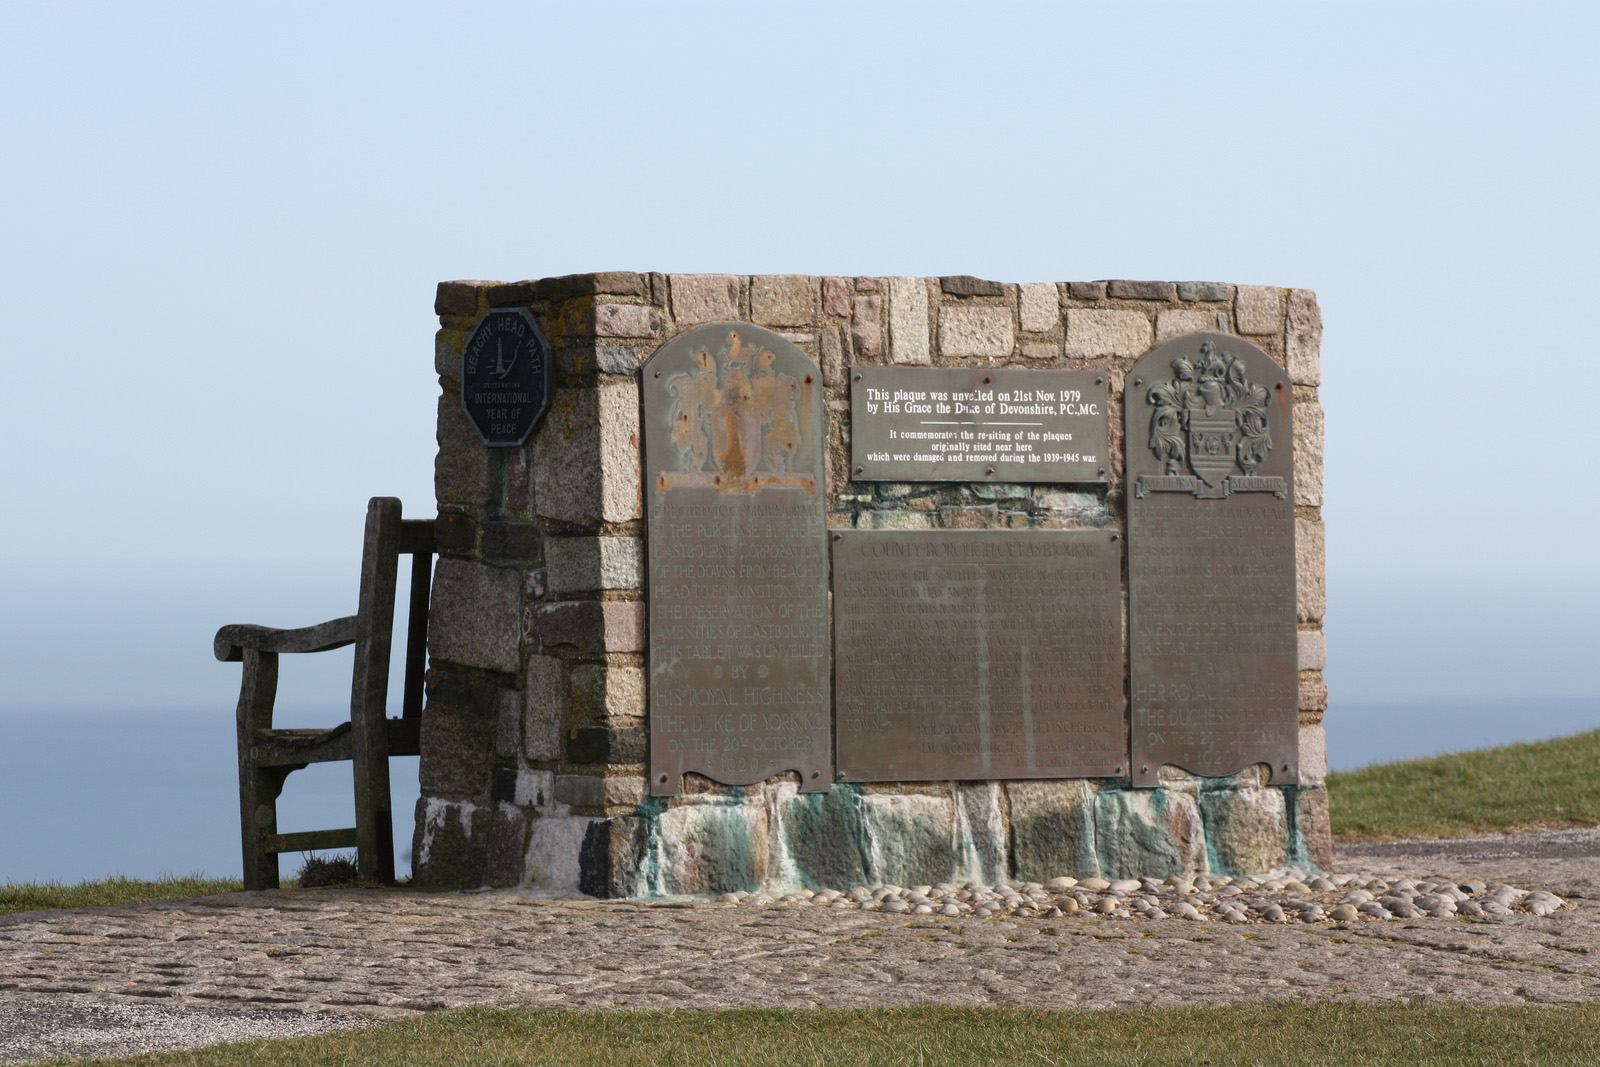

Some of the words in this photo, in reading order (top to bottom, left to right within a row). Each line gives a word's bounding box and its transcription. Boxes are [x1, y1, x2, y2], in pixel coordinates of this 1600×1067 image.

[467, 322, 493, 375] BEACHY
[498, 317, 526, 338] HEAD
[526, 337, 542, 375] PATH
[474, 392, 533, 405] INTERNATIONAL
[866, 388, 890, 401] This
[894, 389, 927, 404] plaque
[930, 391, 948, 402] was
[998, 392, 1011, 402] on
[1013, 390, 1033, 402] 21st
[1036, 390, 1056, 402] Nov.
[1060, 390, 1081, 402] 1979
[486, 408, 508, 420] YEAR
[511, 408, 522, 420] OF
[866, 401, 879, 416] by
[883, 402, 900, 414] His
[904, 402, 932, 414] Grace
[936, 402, 951, 414] the
[984, 402, 996, 414] of
[1000, 403, 1057, 416] Devonshire,
[490, 423, 517, 436] PEACE
[889, 429, 897, 439] It
[960, 430, 974, 440] the
[977, 431, 1011, 442] re-siting
[1014, 431, 1024, 441] of
[1027, 431, 1040, 441] the
[1043, 431, 1073, 443] plaques
[931, 441, 970, 453] originally
[973, 442, 992, 452] sited
[995, 444, 1012, 452] near
[1015, 443, 1033, 452] here
[866, 452, 890, 462] which
[893, 454, 911, 462] were
[948, 452, 963, 463] and
[965, 453, 998, 463] removed
[1000, 453, 1025, 464] during
[1028, 453, 1041, 463] the
[1043, 453, 1080, 464] 1939-1945
[1082, 454, 1097, 463] war.
[669, 523, 694, 538] THE
[697, 523, 760, 538] PURCHASE
[765, 523, 778, 538] BY
[784, 523, 807, 538] THE
[654, 543, 736, 559] EASTBOURNE
[739, 543, 823, 559] CORPORATION
[654, 564, 669, 579] OF
[673, 564, 696, 579] THE
[697, 564, 736, 579] DOWNS
[739, 564, 772, 579] FROM
[773, 564, 822, 579] BEACHY
[655, 584, 690, 599] HEAD
[693, 584, 709, 599] TO
[797, 584, 823, 599] FOR
[655, 604, 683, 619] THE
[685, 604, 776, 619] PRESERVATION
[778, 604, 794, 619] OF
[798, 604, 825, 619] THE
[655, 624, 726, 640] AMENITIES
[726, 624, 741, 640] OF
[743, 624, 826, 640] EASTBOURNE
[655, 644, 683, 660] THIS
[686, 644, 734, 660] TABLET
[736, 644, 761, 660] WAS
[763, 644, 825, 660] UNVEILED
[731, 664, 750, 680] BY
[655, 686, 682, 706] HIS
[688, 686, 739, 706] ROYAL
[744, 686, 825, 706] HIGHNESS
[655, 712, 689, 733] THE
[692, 712, 735, 733] DUKE
[739, 712, 758, 733] OF
[668, 738, 688, 753] ON
[692, 737, 718, 752] THE
[753, 736, 812, 751] OCTOBER
